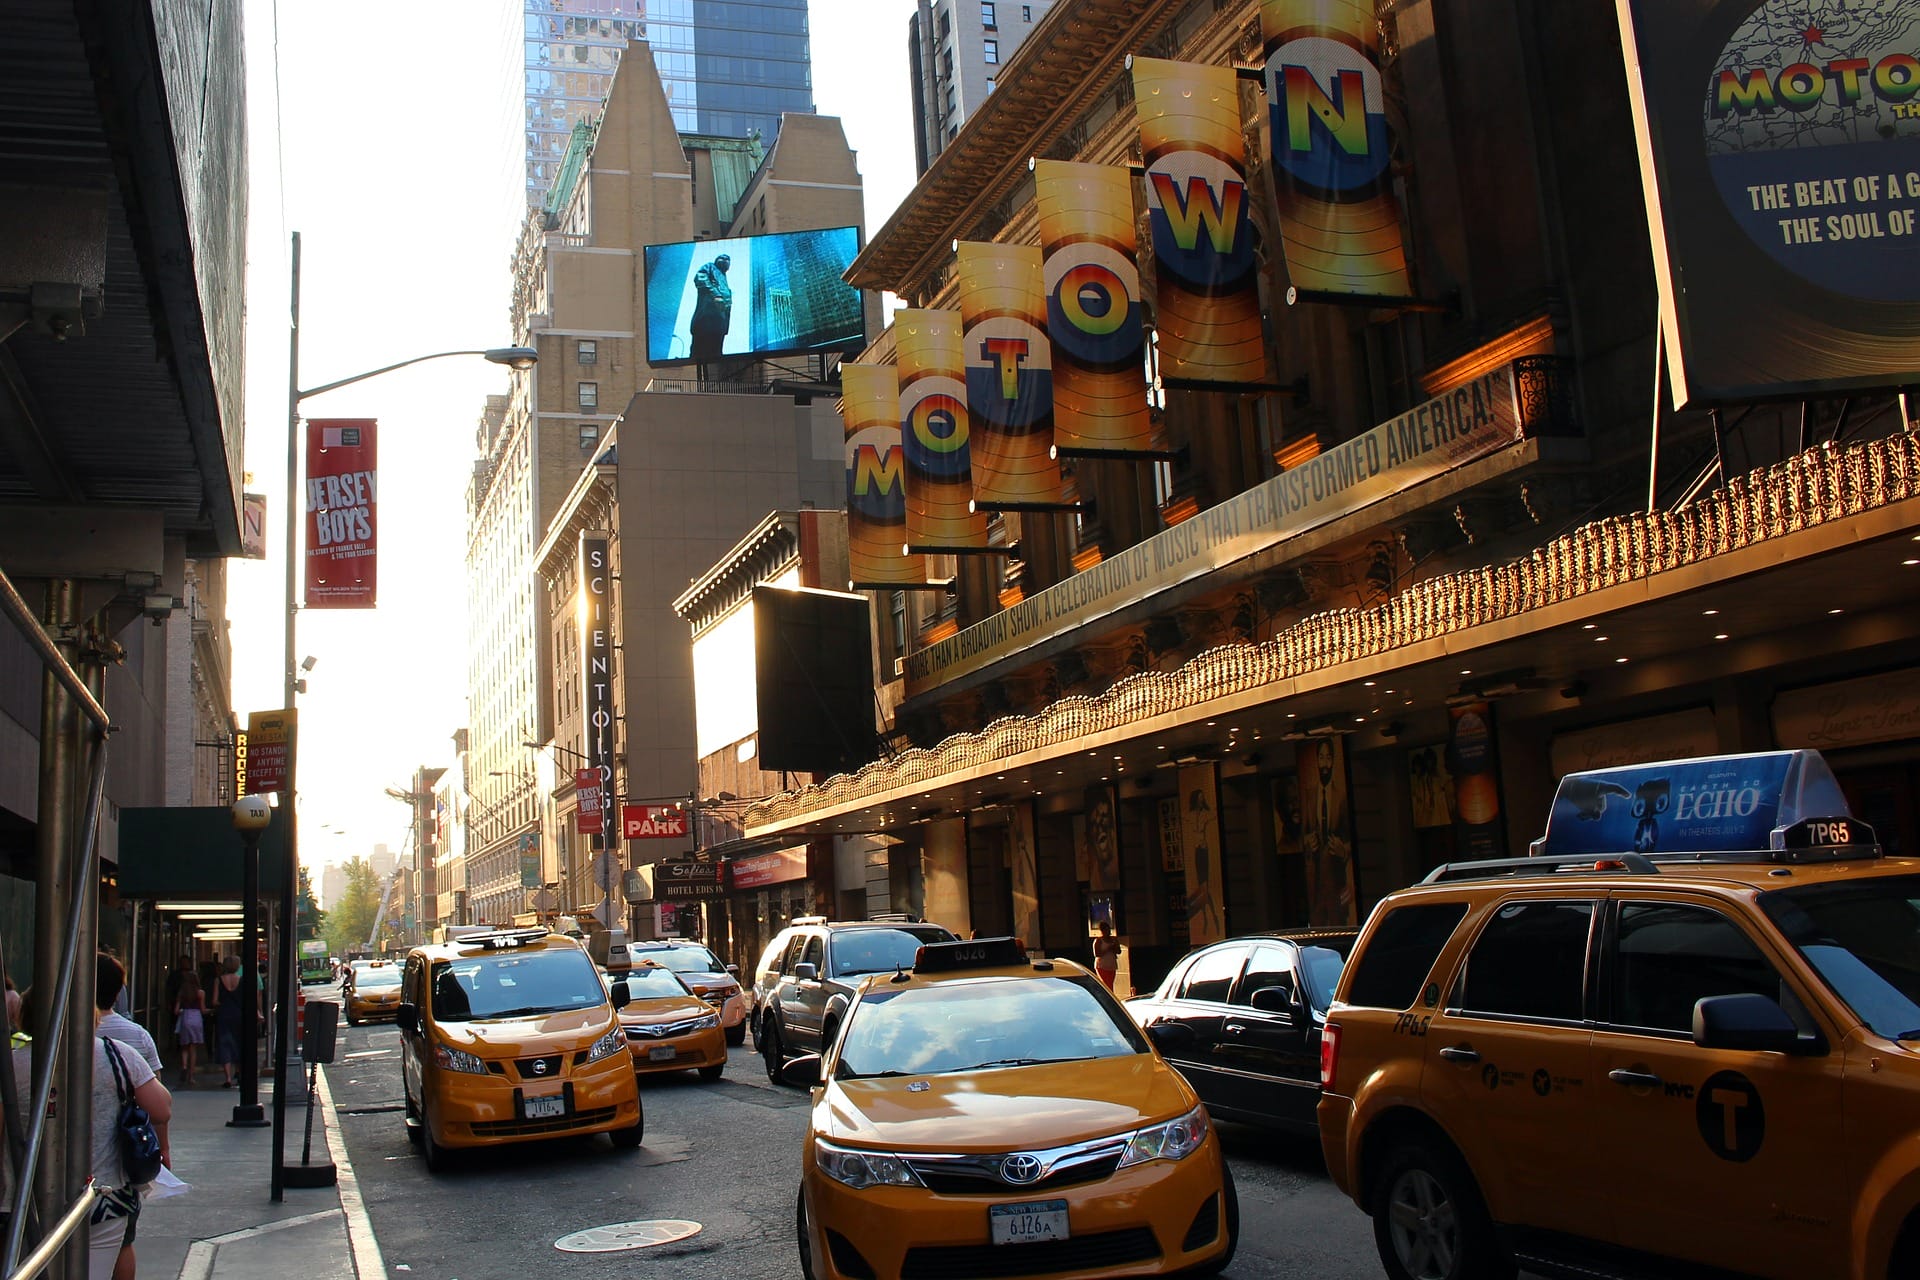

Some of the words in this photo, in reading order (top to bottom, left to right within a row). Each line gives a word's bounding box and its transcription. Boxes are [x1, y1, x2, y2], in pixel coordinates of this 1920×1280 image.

[1747, 184, 1791, 211] THE
[1794, 178, 1847, 207] BEAT
[1853, 175, 1880, 202] OF
[1887, 174, 1902, 200] A
[1778, 217, 1824, 245] THE
[1826, 212, 1885, 241] SOUL
[1888, 209, 1915, 236] OF
[306, 471, 377, 512] JERSEY
[316, 506, 372, 546] BOYS
[909, 650, 930, 681] MORE
[930, 640, 952, 672] THAN
[953, 636, 960, 662] A
[960, 615, 1008, 659] BROADWAY
[1010, 601, 1042, 637] SHOW,
[1044, 595, 1052, 622] A
[1054, 554, 1131, 618] CELEBRATION
[1134, 544, 1149, 581] OF
[1153, 519, 1199, 573] MUSIC
[1202, 498, 1241, 550] THAT
[1244, 434, 1380, 531] TRANSFORMED
[250, 748, 260, 757] NO
[257, 757, 285, 767] ANYTIME
[248, 768, 272, 779] EXCEPT
[1680, 782, 1729, 793] EARTH
[1743, 779, 1760, 787] TO
[581, 799, 599, 812] BOYS
[1674, 787, 1761, 820] ECHO
[250, 809, 264, 818] TAXI
[628, 820, 682, 835] PARK
[1807, 822, 1850, 844] 7P65
[667, 886, 693, 895] HOTEL
[1393, 1013, 1432, 1037] 7P65
[1664, 1082, 1695, 1098] NYC
